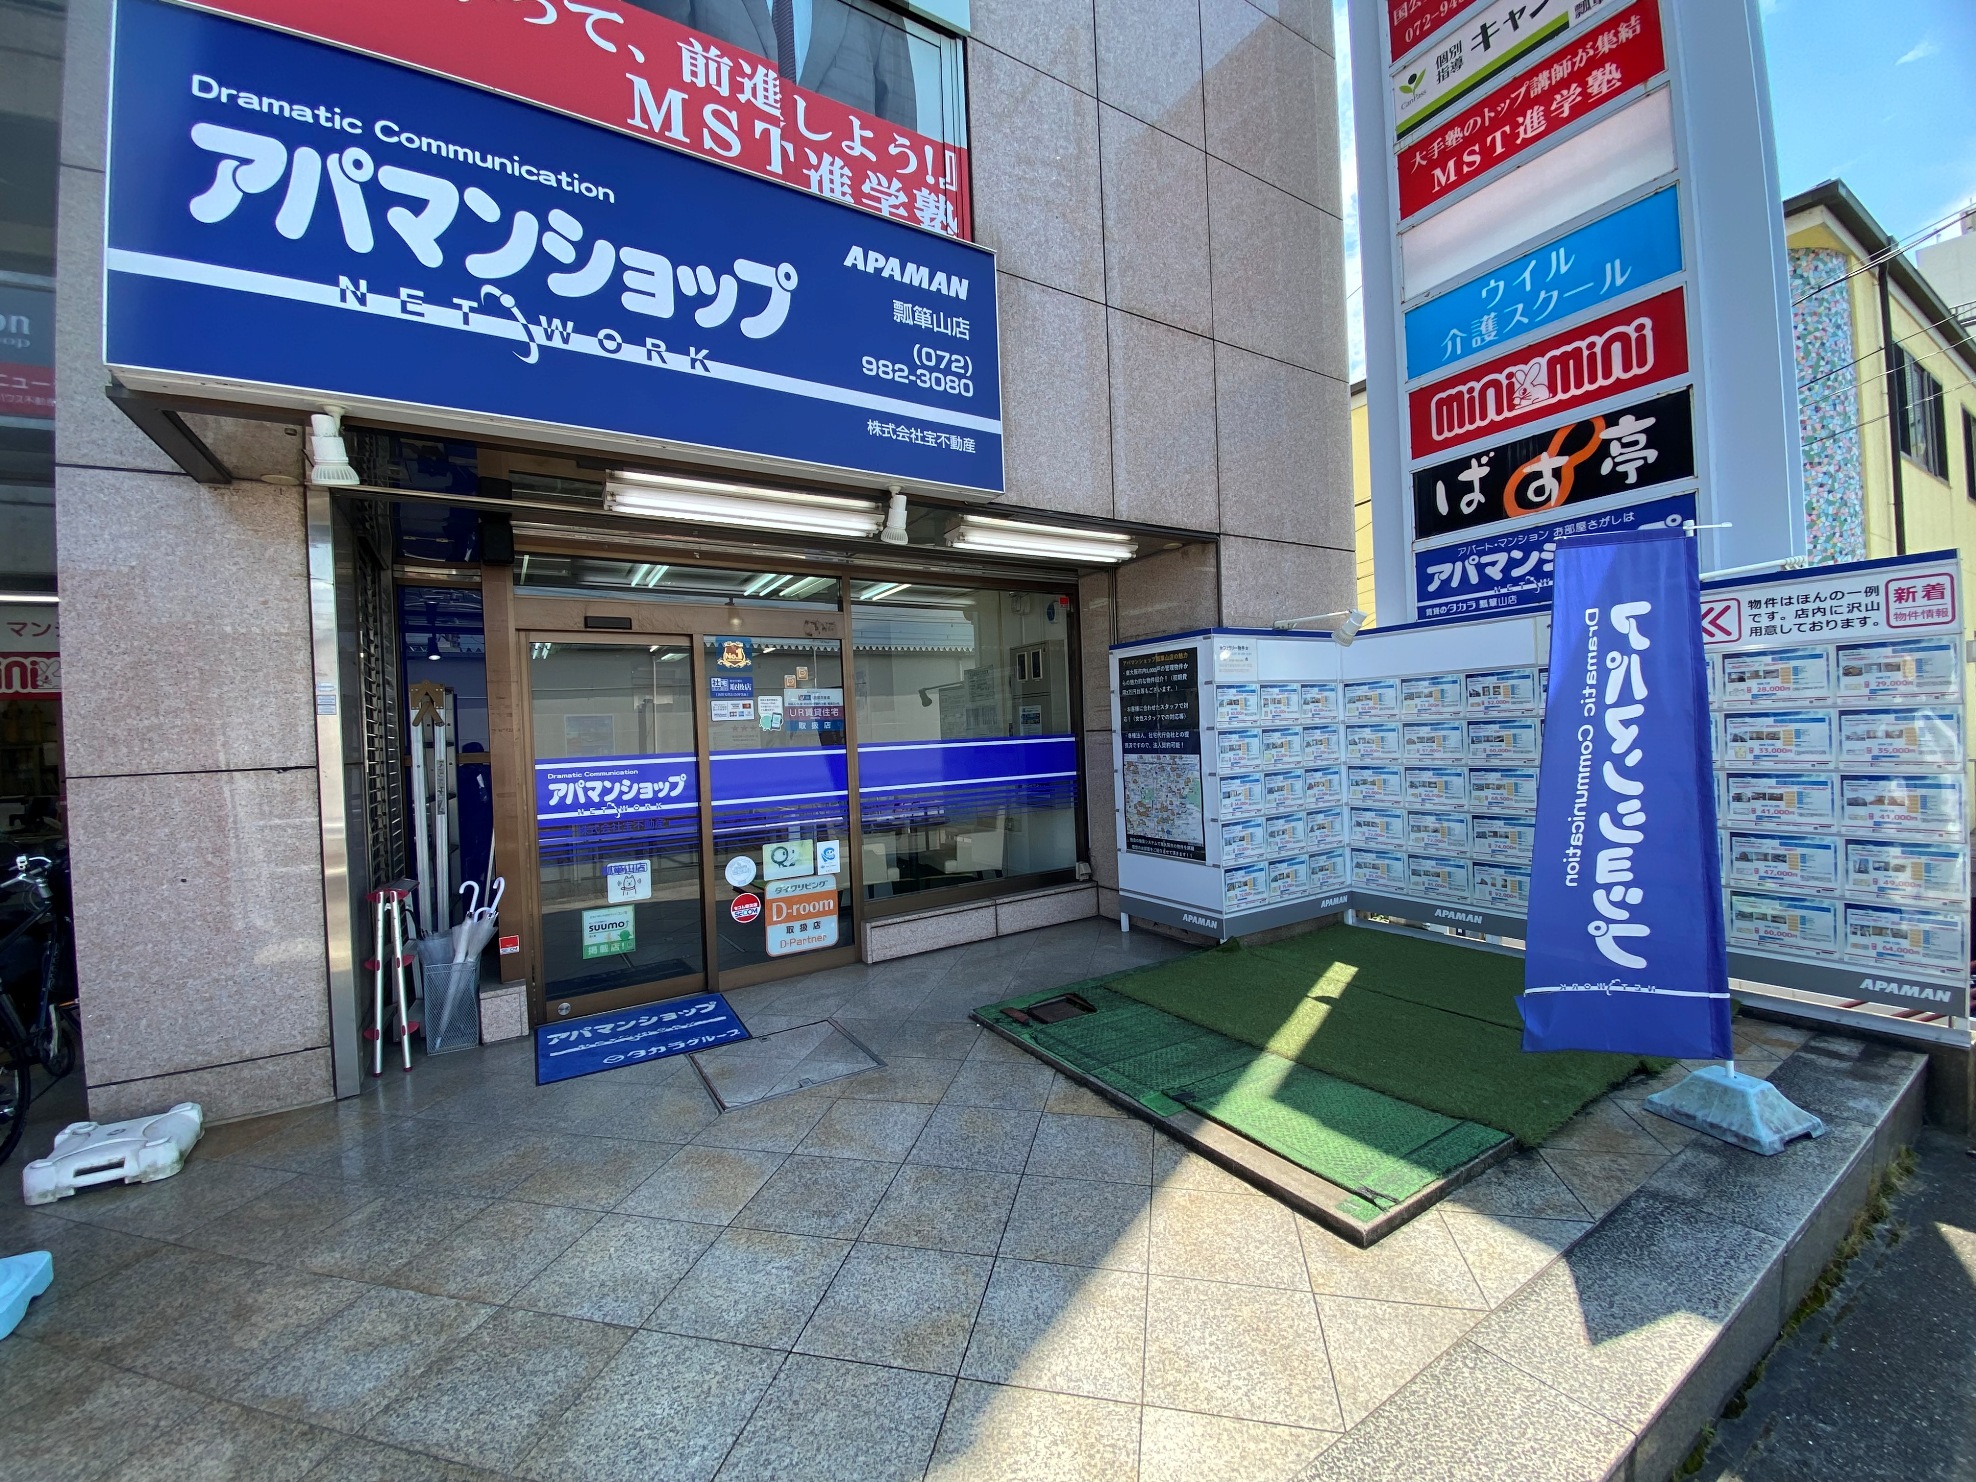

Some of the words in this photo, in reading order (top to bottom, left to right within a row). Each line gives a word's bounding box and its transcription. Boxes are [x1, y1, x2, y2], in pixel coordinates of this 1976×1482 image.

[1411, 14, 1640, 173] 大手塾のトップ講師が集結
[191, 74, 363, 135] Dramatic
[374, 120, 615, 204] Communication
[189, 122, 798, 339] アパマンショップ
[843, 245, 969, 300] APAMAN
[1441, 258, 1632, 362] 介護スクール
[912, 344, 973, 377] (072)
[861, 356, 974, 397] 982-3080
[1431, 366, 1516, 441] mini
[1547, 317, 1654, 400] mini
[867, 420, 976, 453] 株式会社宝不動産
[1747, 585, 1880, 610] 物件はほんの一例
[1893, 583, 1946, 604] 新着
[1748, 601, 1880, 623] です。店内に沢山
[1893, 608, 1949, 622] 物件情報
[1749, 617, 1880, 637] 用意しております。
[584, 769, 638, 777] Communication
[548, 774, 687, 806] アパマンショップ
[772, 899, 834, 922] D-room
[1321, 895, 1348, 908] APAMAN
[786, 921, 821, 934] 取扱店
[1183, 914, 1217, 929] APAMAN
[1434, 909, 1482, 924] APAMAN
[780, 935, 827, 949] D-Partner
[1859, 979, 1952, 1003] APAMAN
[547, 1001, 717, 1045] アパマンショップ
